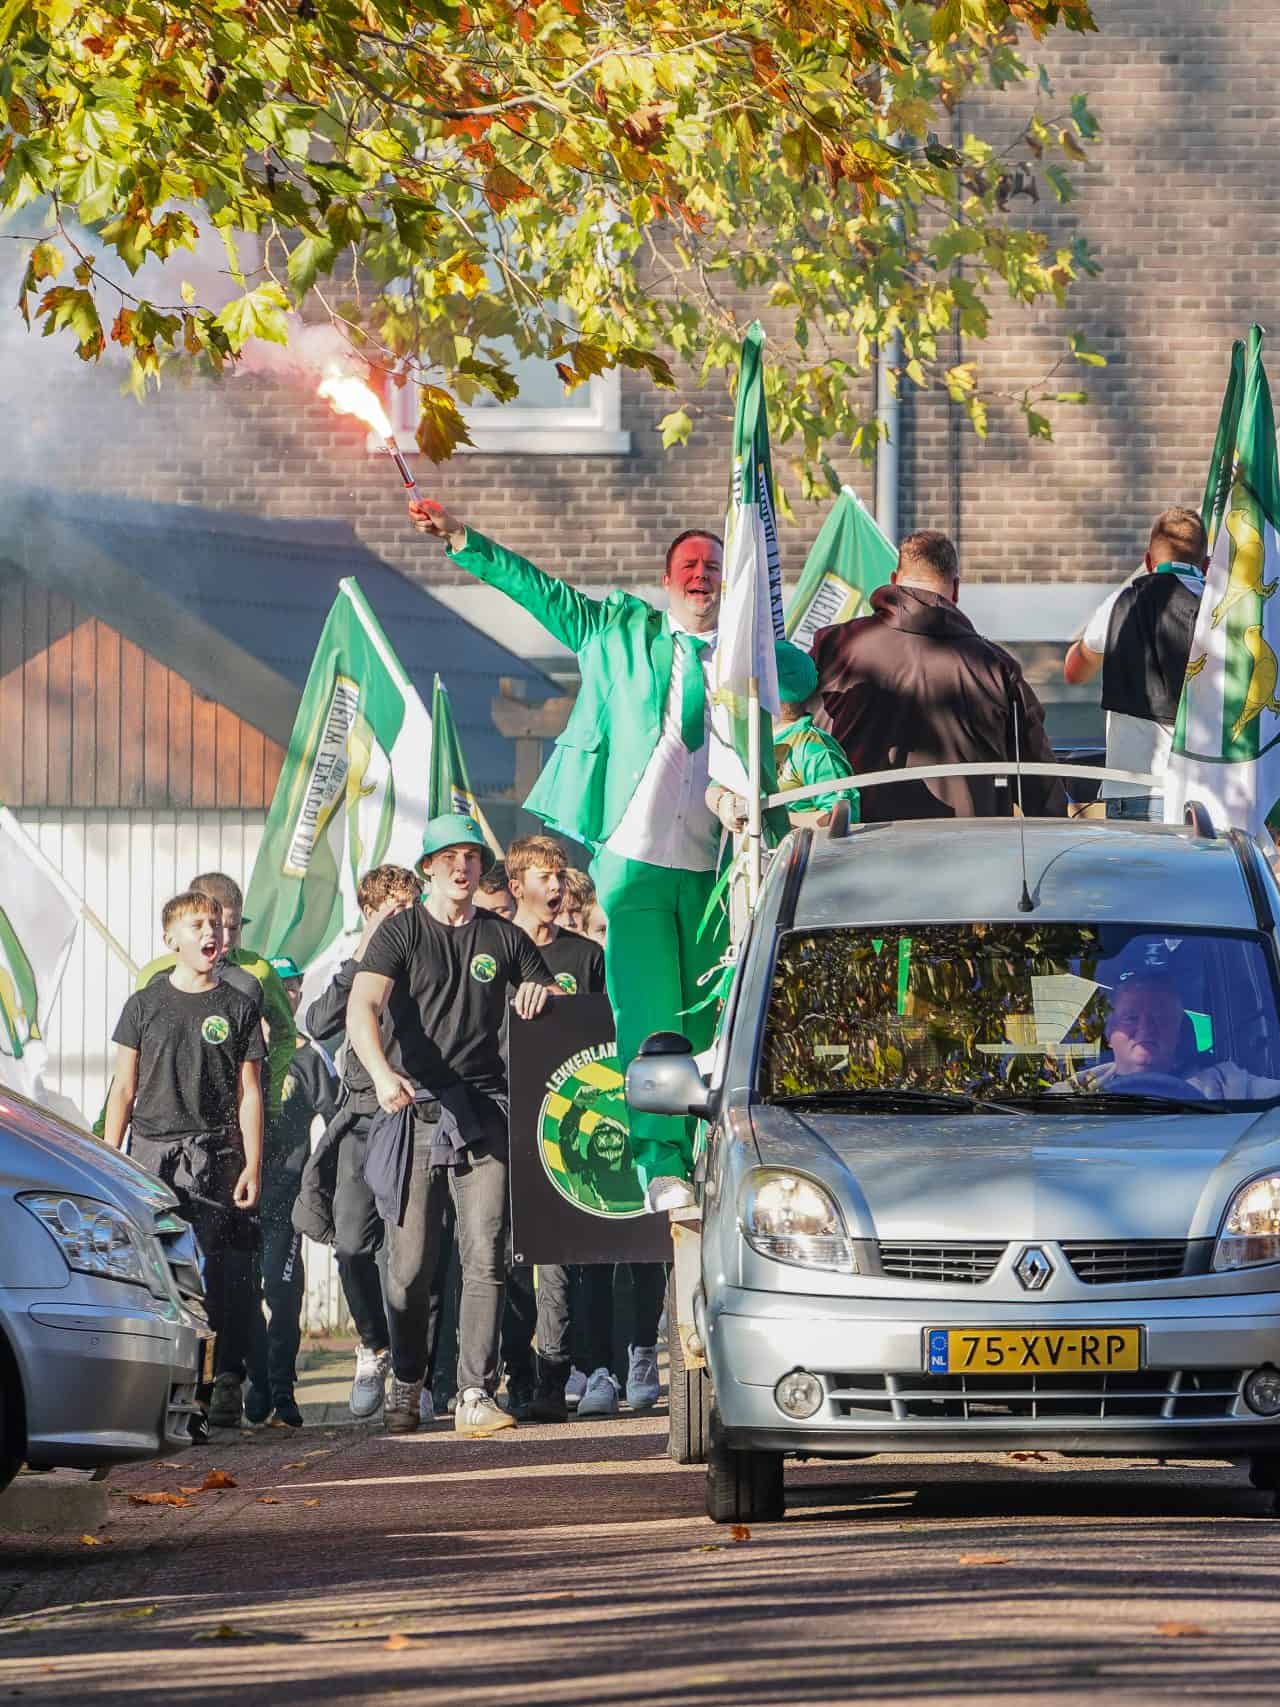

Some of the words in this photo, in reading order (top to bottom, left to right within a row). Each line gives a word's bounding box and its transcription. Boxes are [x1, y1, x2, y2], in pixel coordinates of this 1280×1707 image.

[545, 1041, 618, 1092] LEKKERLAN
[931, 1355, 947, 1366] NL
[961, 1335, 1126, 1367] 75-XV-RP
